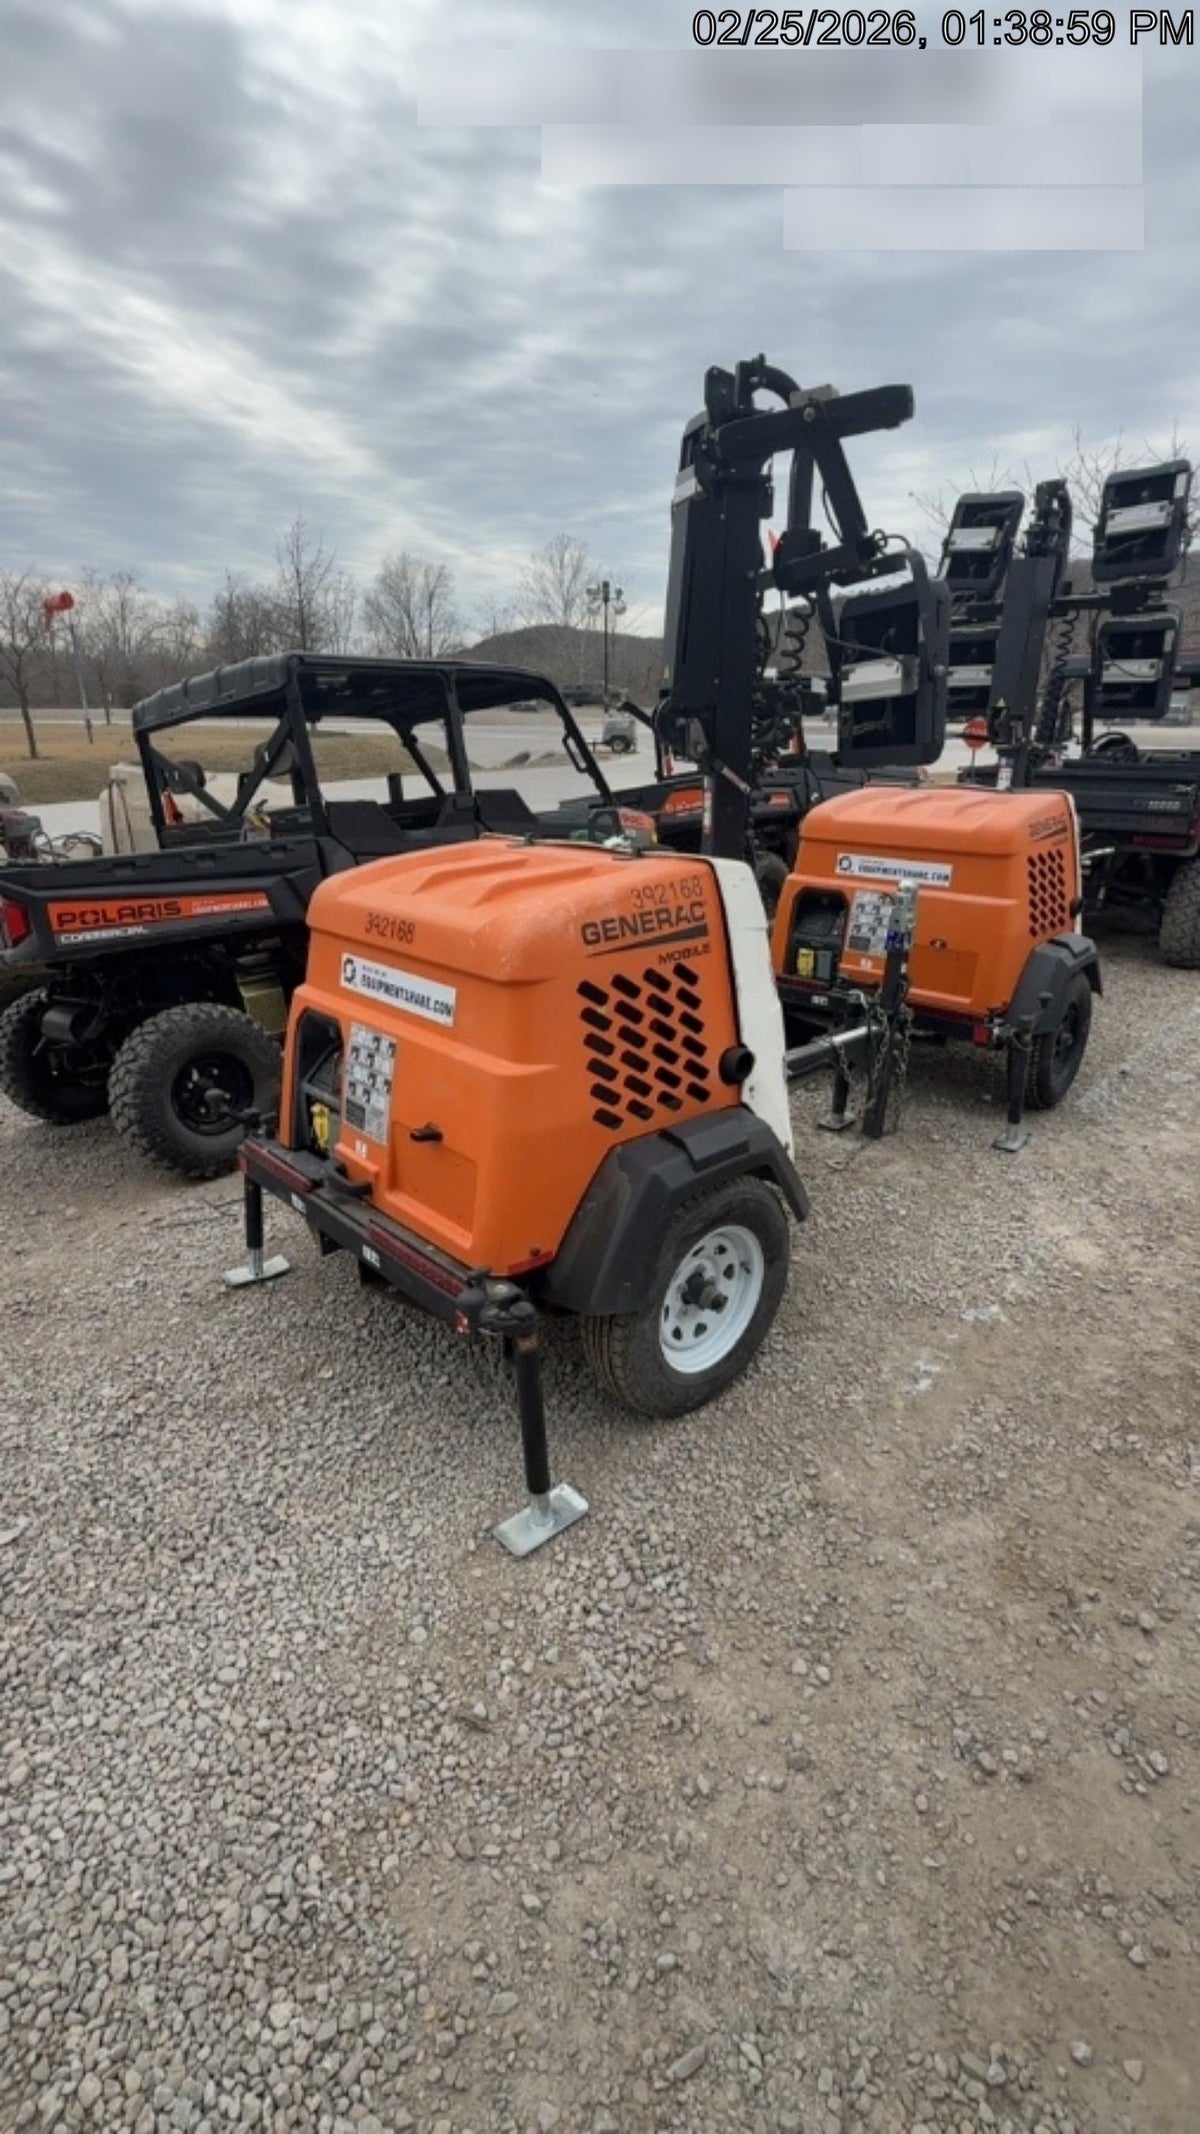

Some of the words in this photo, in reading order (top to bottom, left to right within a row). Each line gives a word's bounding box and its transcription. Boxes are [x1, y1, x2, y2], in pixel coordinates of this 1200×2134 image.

[629, 874, 704, 910] 392168
[56, 900, 182, 929] POLARIS
[580, 900, 706, 947] GENERAC
[657, 942, 711, 966] MOBILE
